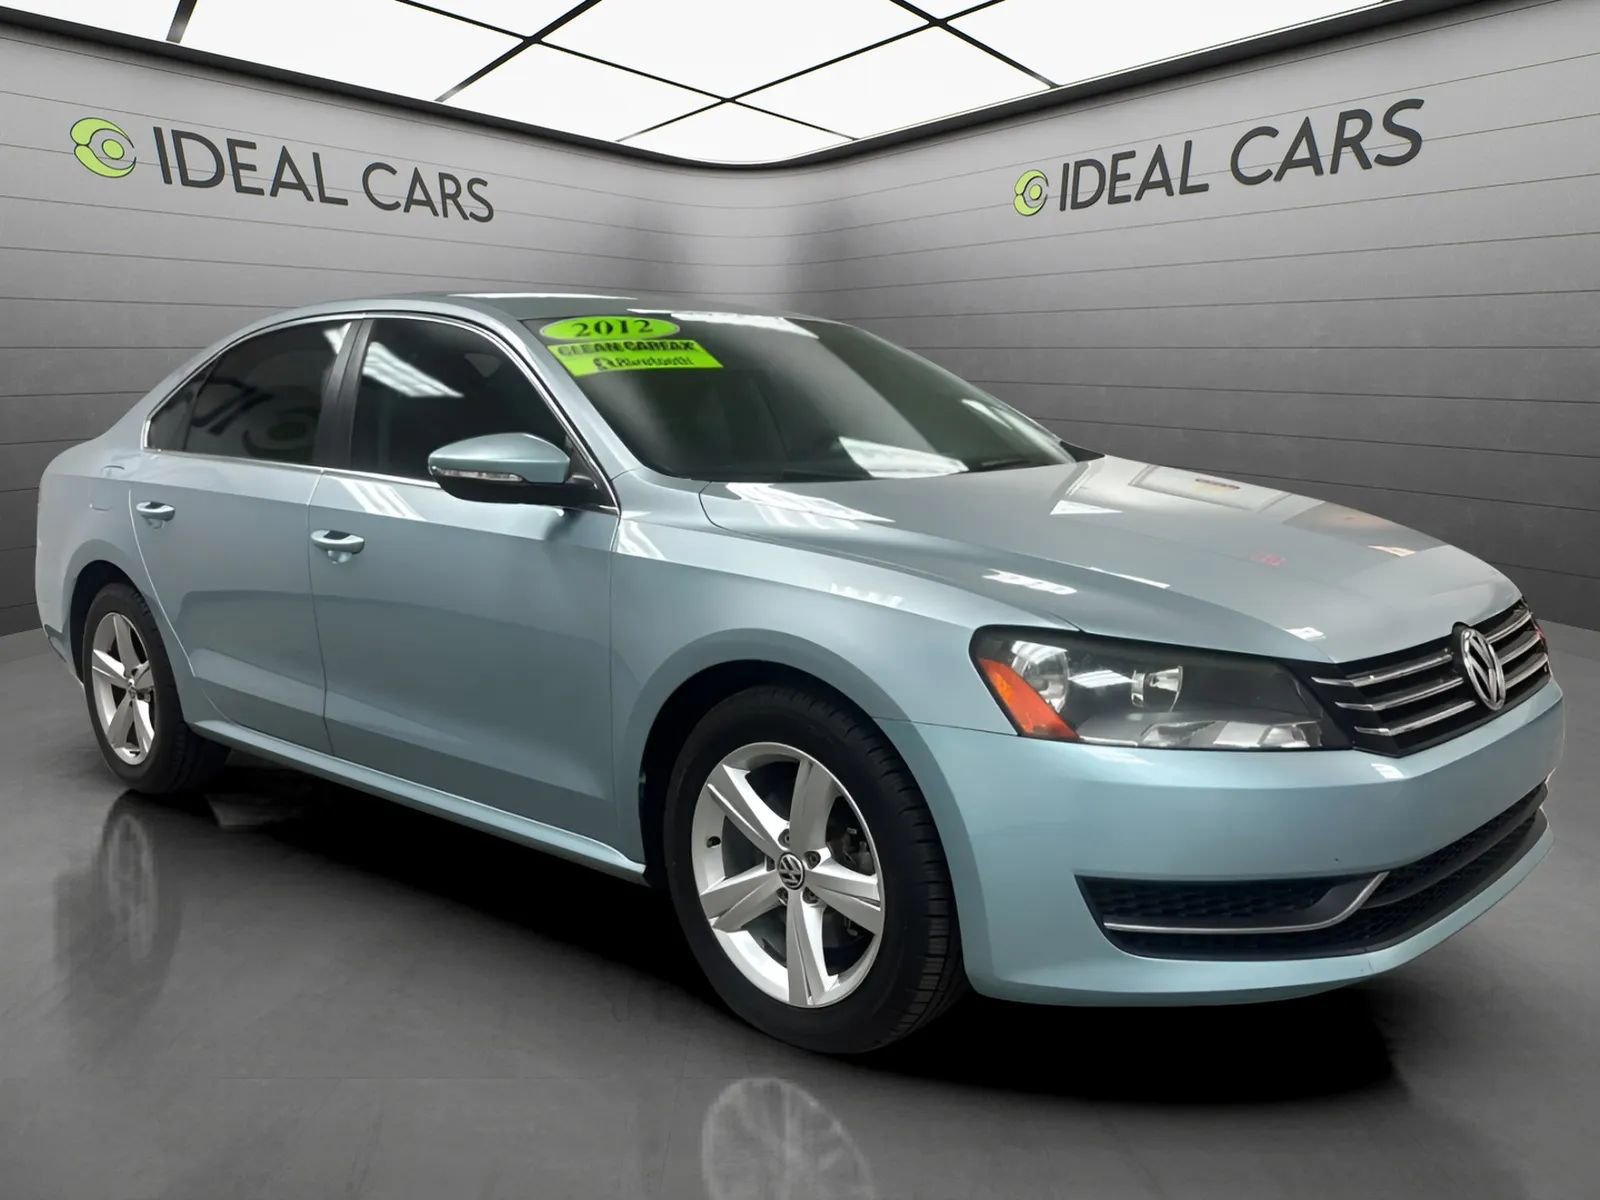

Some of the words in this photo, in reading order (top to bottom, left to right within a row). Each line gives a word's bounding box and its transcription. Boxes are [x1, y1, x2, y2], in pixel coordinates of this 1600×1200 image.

[153, 126, 348, 206] IDEAL
[362, 162, 494, 223] CARS
[1059, 140, 1209, 212] IDEAL
[1230, 98, 1425, 186] CARS
[558, 341, 622, 357] CLEAN
[571, 319, 654, 338] 2012
